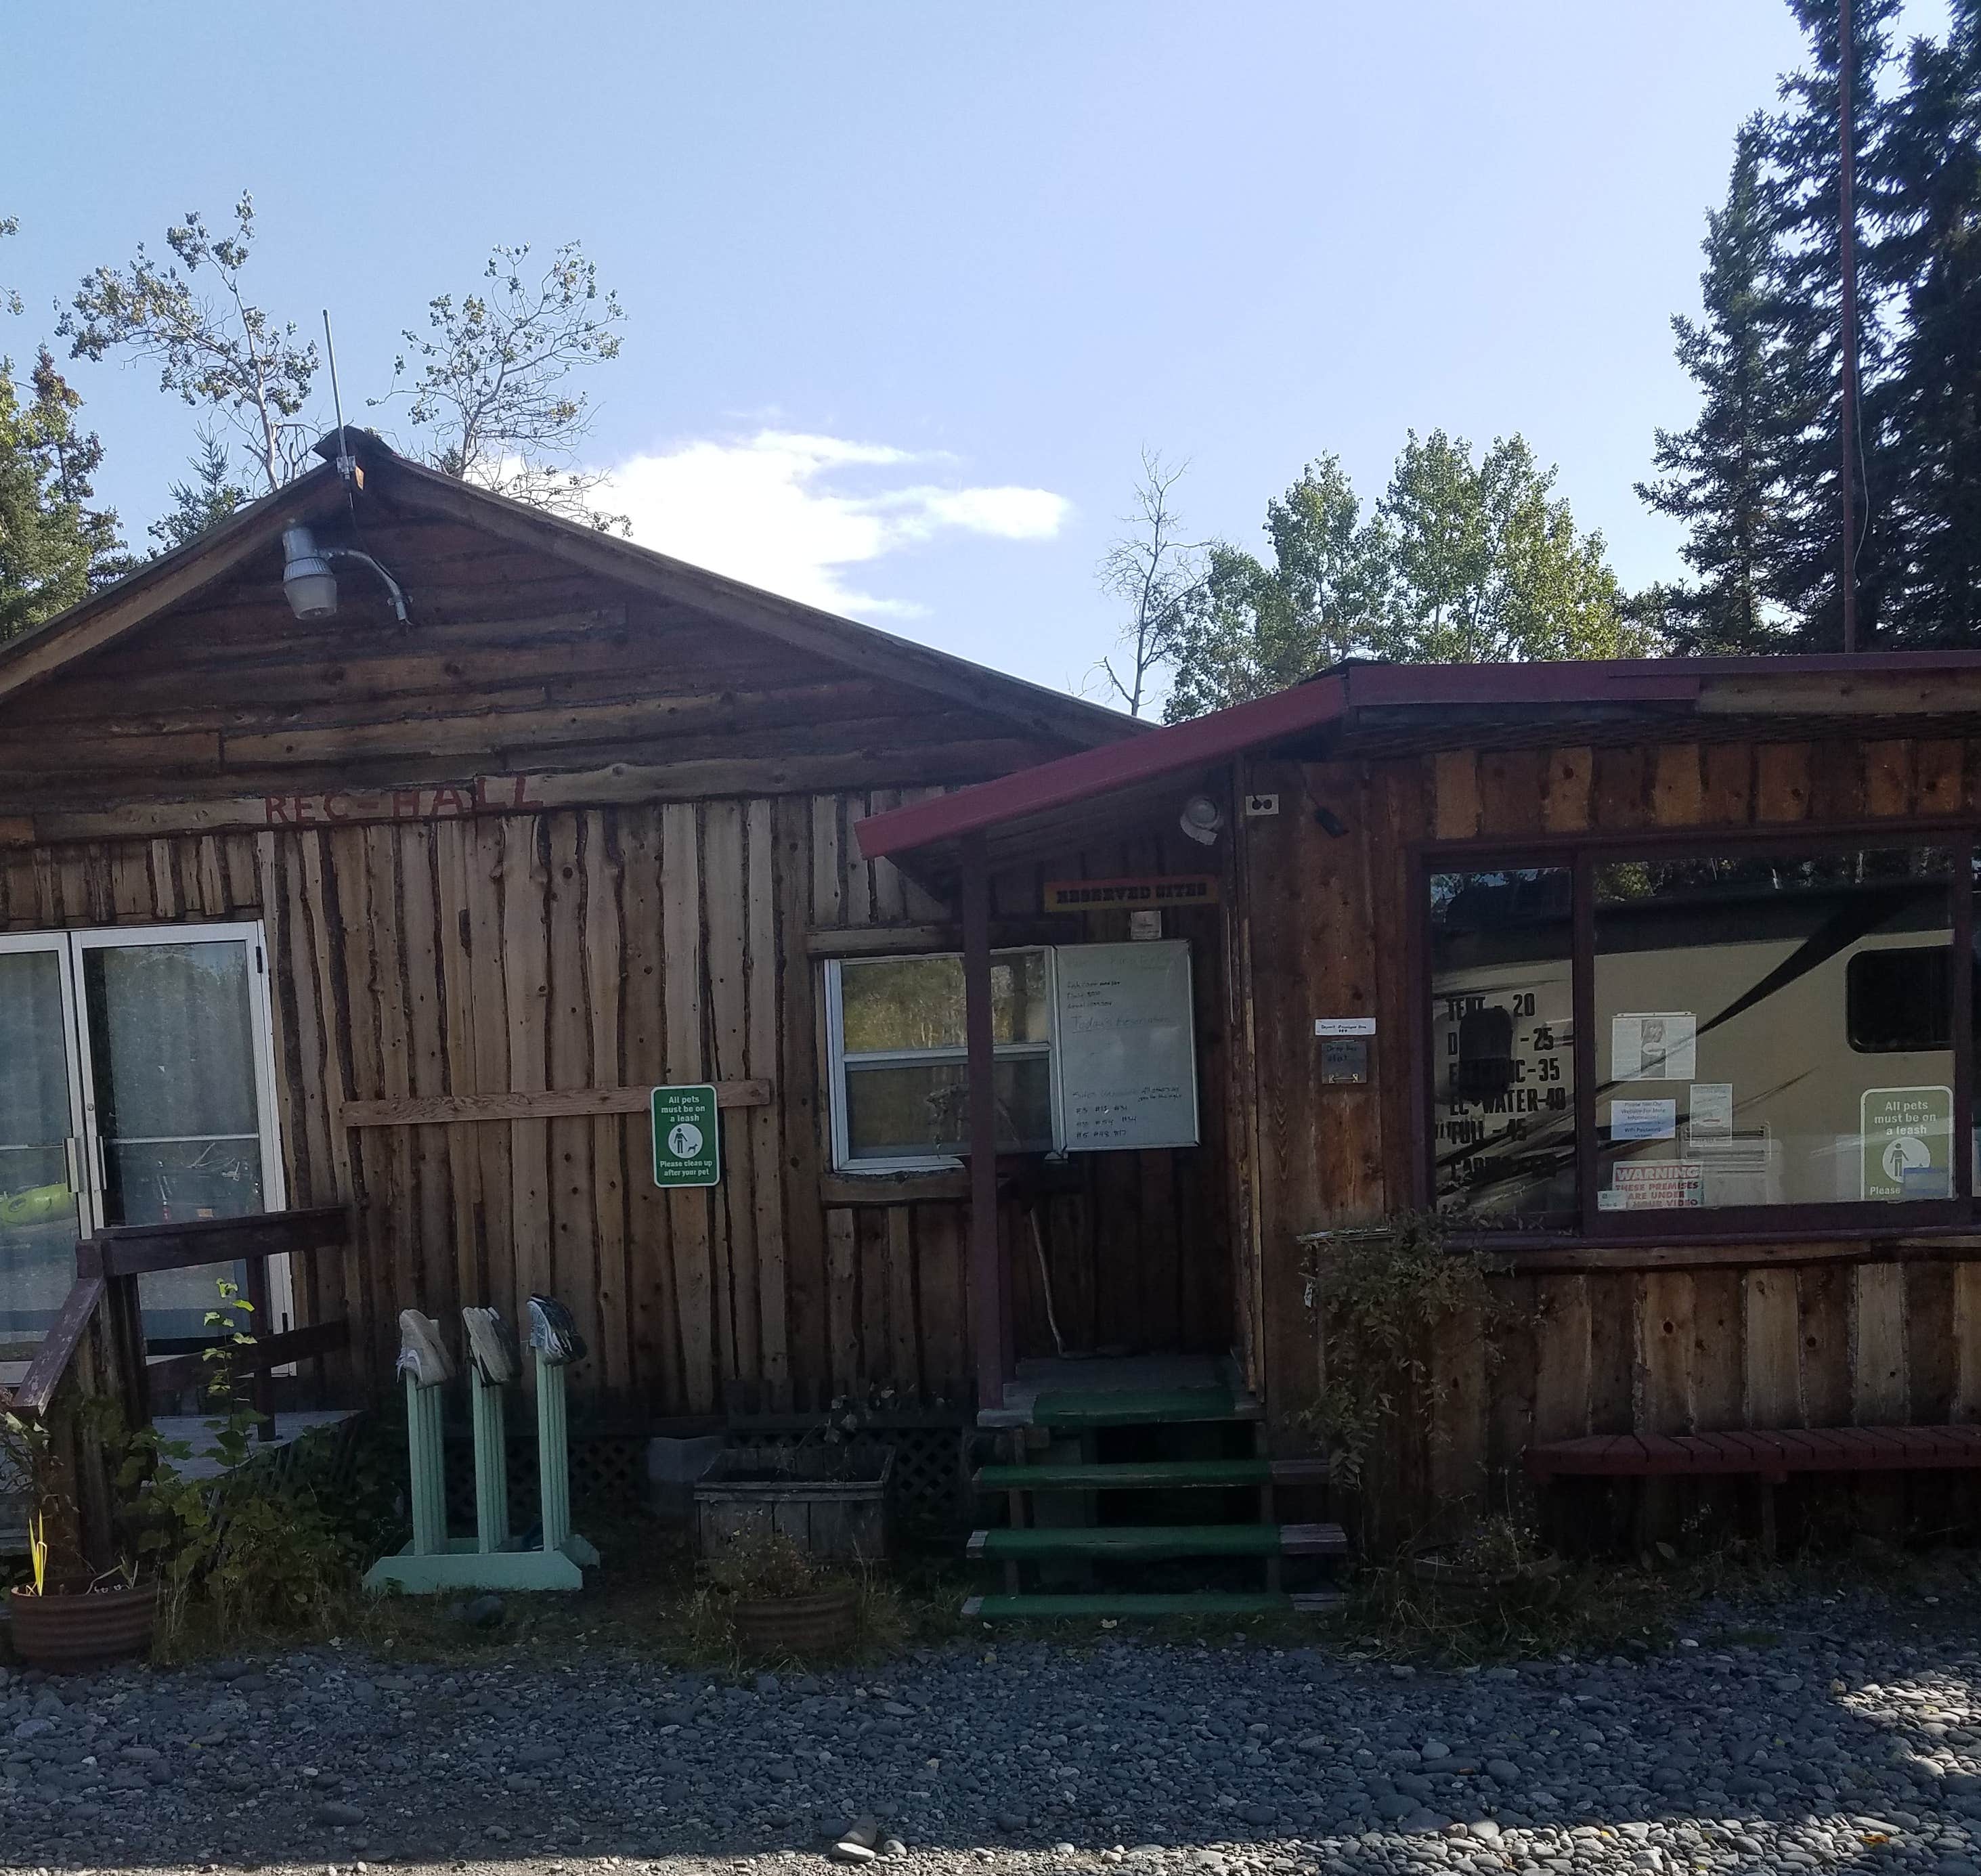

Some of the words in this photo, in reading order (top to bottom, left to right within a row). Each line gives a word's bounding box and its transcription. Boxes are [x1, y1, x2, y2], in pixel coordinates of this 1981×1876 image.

[1512, 992, 1535, 1017] 20
[1533, 1027, 1554, 1051] 25
[682, 1096, 699, 1104] pets
[1886, 1101, 1900, 1111] All
[1904, 1100, 1928, 1111] pets
[1874, 1114, 1902, 1124] must
[1905, 1112, 1919, 1122] be
[1886, 1127, 1893, 1135] a
[1896, 1125, 1927, 1135] leash
[1617, 1167, 1699, 1180] WARNING
[1616, 1183, 1645, 1192] THESE
[1649, 1181, 1698, 1191] PREMISES
[1870, 1186, 1900, 1195] Please
[1651, 1191, 1684, 1199] UNDER
